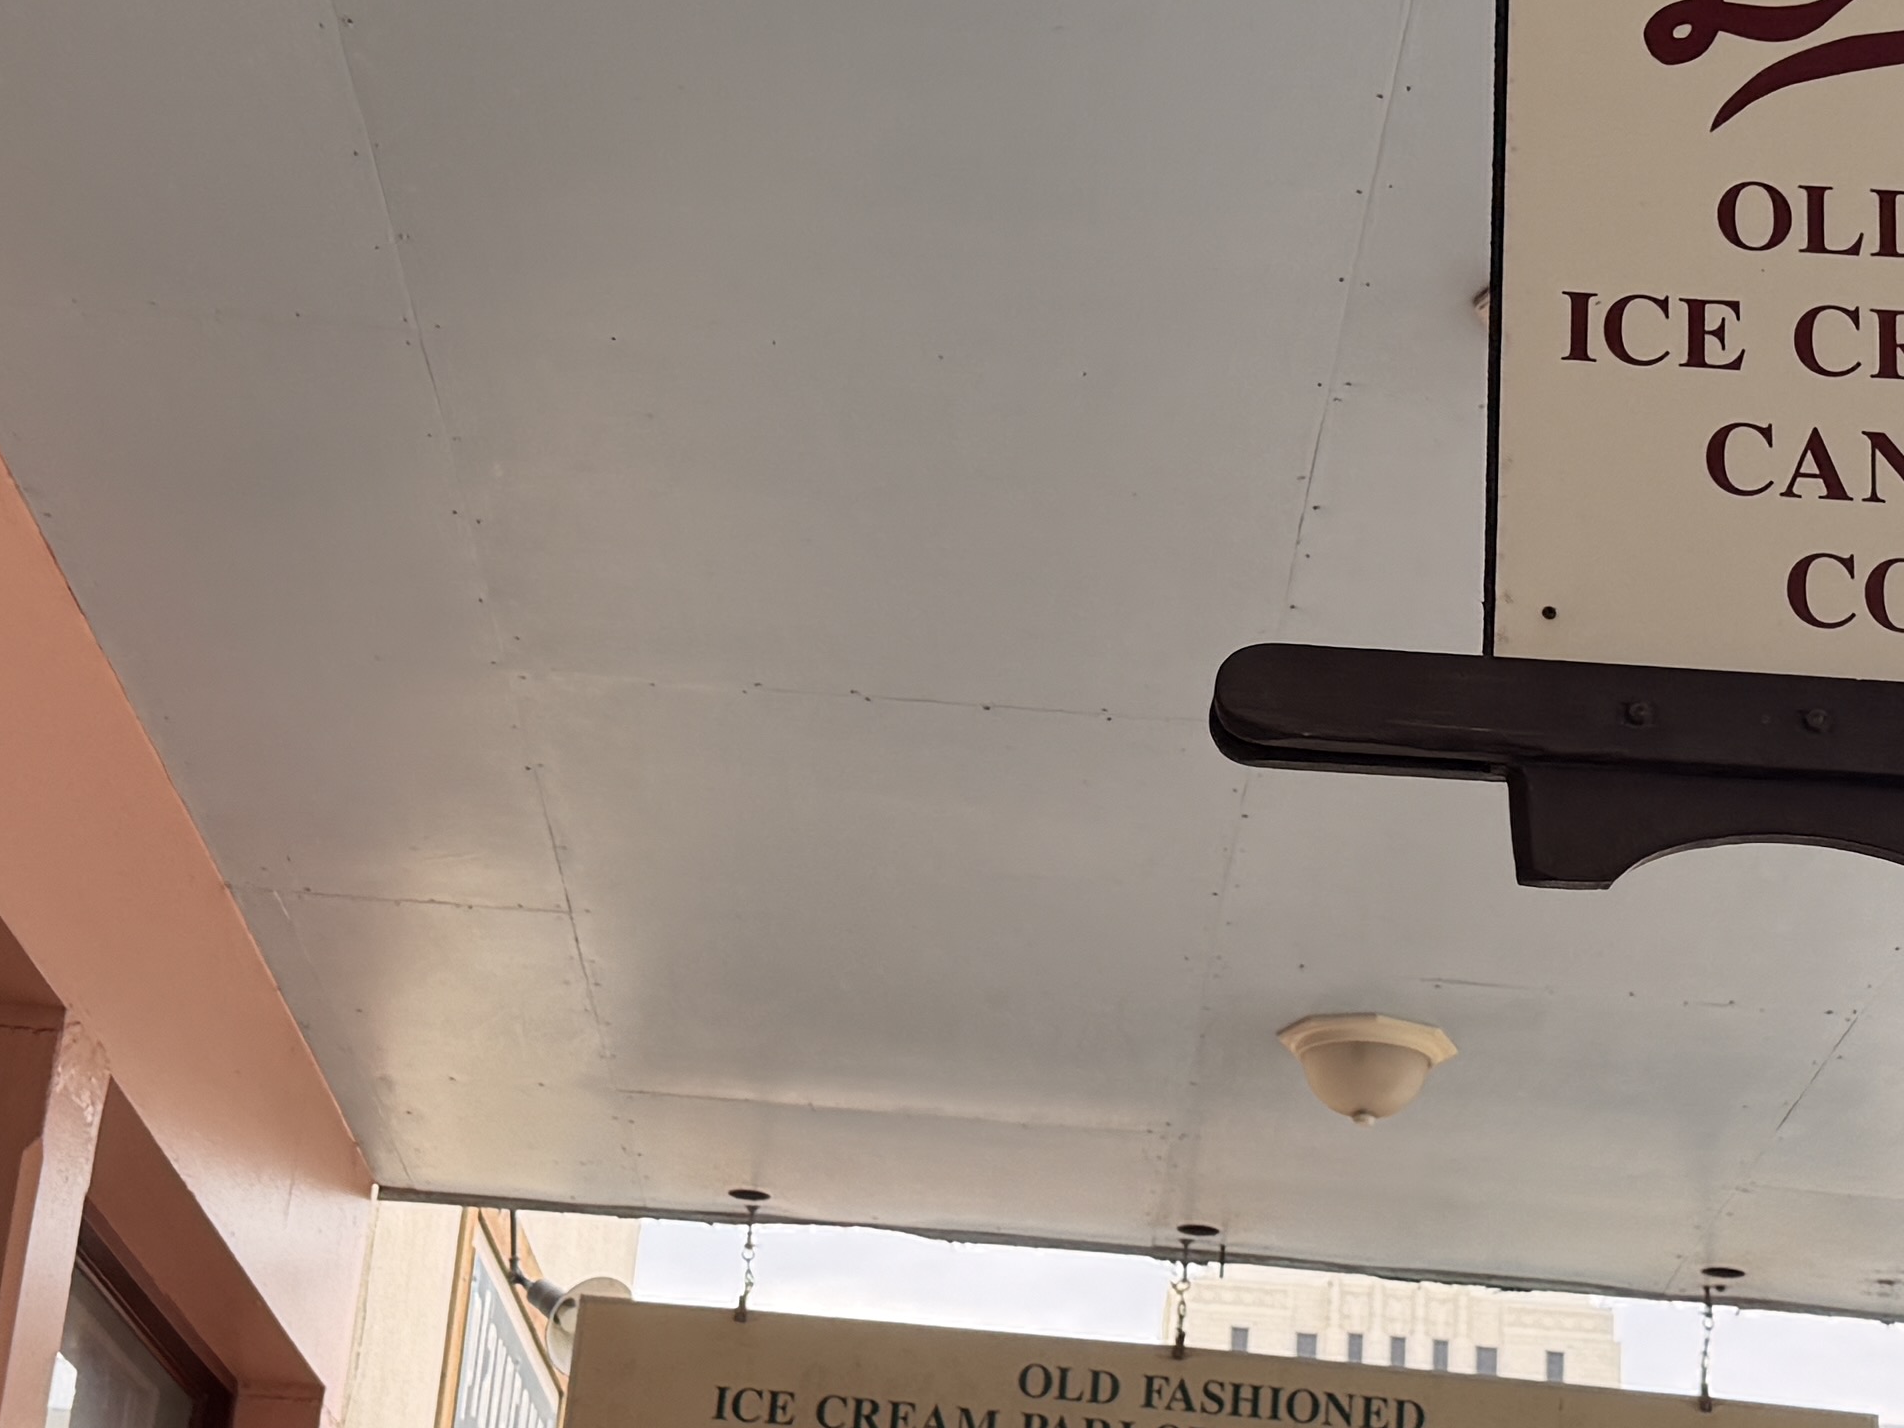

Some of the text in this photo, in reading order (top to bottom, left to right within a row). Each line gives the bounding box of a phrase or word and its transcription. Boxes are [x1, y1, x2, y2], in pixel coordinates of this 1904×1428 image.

[1560, 290, 1747, 372] ICE
[1017, 1363, 1121, 1404] OLD
[711, 1384, 796, 1427] ICE
